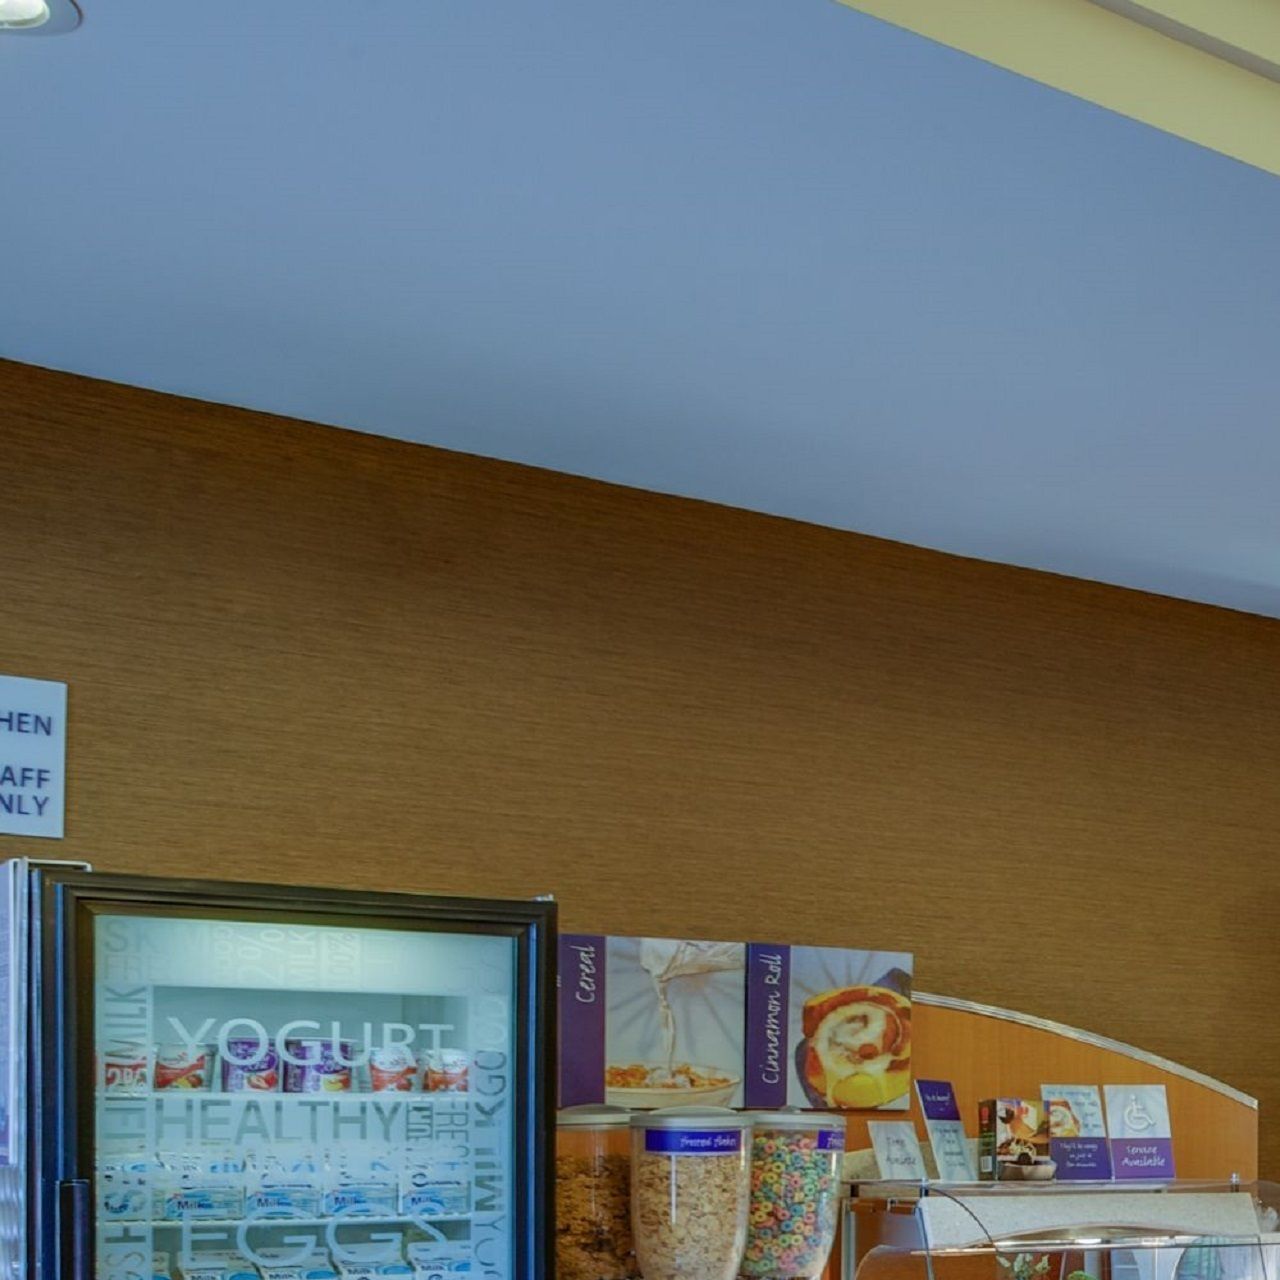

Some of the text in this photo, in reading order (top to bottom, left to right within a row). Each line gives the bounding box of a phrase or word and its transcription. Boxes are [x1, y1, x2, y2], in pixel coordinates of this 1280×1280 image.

[571, 945, 595, 1003] Cereal
[167, 1016, 455, 1068] YOGURT
[760, 952, 782, 1084] Cinnamon Roll
[155, 1098, 402, 1146] HEALTHY
[181, 1202, 450, 1268] EGGS
